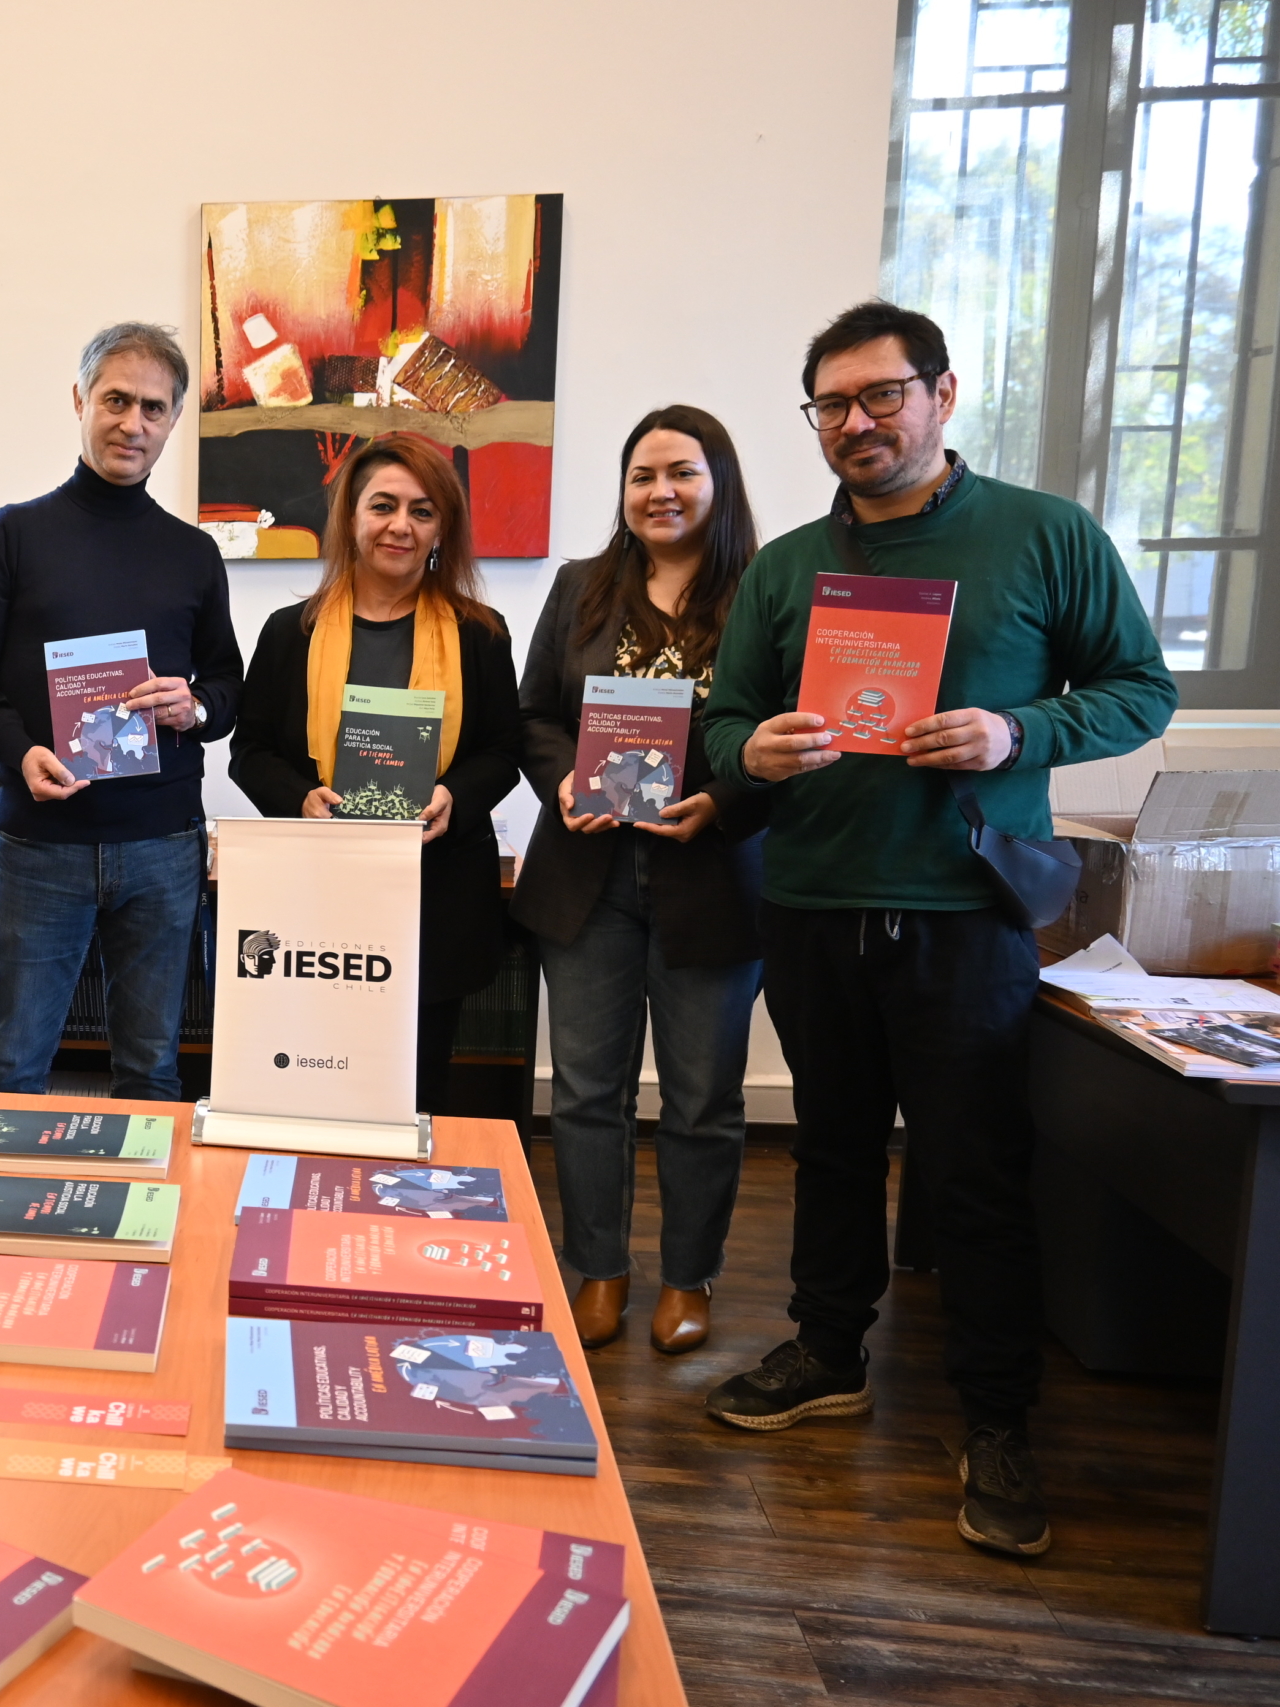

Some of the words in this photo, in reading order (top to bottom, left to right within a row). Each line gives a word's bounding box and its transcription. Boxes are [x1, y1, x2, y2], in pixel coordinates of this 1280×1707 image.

[816, 628, 874, 639] COOPERACIÓN
[816, 637, 900, 650] INTERUNIVERSITARIA
[843, 646, 900, 658] INVESTIGACIÓN
[836, 655, 881, 666] FORMACIÓN
[883, 661, 921, 669] AVANZADA
[54, 674, 85, 683] POLÍTICAS
[878, 667, 918, 677] EDUCACIÓN
[56, 682, 82, 690] CALIDAD
[56, 686, 106, 697] ACCOUNTABILITY
[84, 696, 91, 704] EN
[93, 692, 116, 702] AMÉRICA
[589, 712, 621, 720] POLÍTICAS
[346, 728, 380, 736] EDUCACIÓN
[587, 726, 640, 735] ACCOUNTABILITY
[624, 736, 650, 744] AMÉRICA
[368, 750, 394, 759] TIEMPOS
[285, 940, 386, 952] EDICIONES
[284, 950, 392, 983] IESED
[333, 982, 386, 993] CHILE
[296, 1055, 348, 1070] iesed.cl
[75, 1183, 87, 1194] PARA
[84, 1184, 99, 1208] EDUCACIÓN
[55, 1202, 69, 1215] SOCIAL
[258, 1258, 268, 1271] IESED
[324, 1248, 336, 1282] COOPERACIÓN
[340, 1234, 351, 1283] INTERUNIVERSITARIA
[58, 1264, 79, 1300] COOPERACIÓN
[131, 1273, 142, 1287] IESED
[37, 1264, 65, 1316] INTERUNIVERSITARIA
[265, 1288, 299, 1296] COOPERACIÓN
[300, 1291, 350, 1300] INTERUNIVERSITARIA
[299, 1309, 349, 1317] INTERUNIVERSITARIA
[258, 1390, 268, 1407] IESED
[348, 1366, 368, 1422] ACCOUNTABILITY
[316, 1384, 333, 1419] POLÍTICAS
[335, 1391, 351, 1421] CALIDAD
[70, 1406, 86, 1423] we
[86, 1410, 105, 1424] ka
[105, 1402, 126, 1426] Chill
[58, 1457, 75, 1477] we
[76, 1462, 96, 1478] ka
[96, 1452, 117, 1480] Chill
[568, 1554, 584, 1580] IESED
[420, 1556, 483, 1624] COOPERACIÓN
[372, 1550, 463, 1648] INTERUNIVERSITARIA
[547, 1600, 575, 1626] IESED
